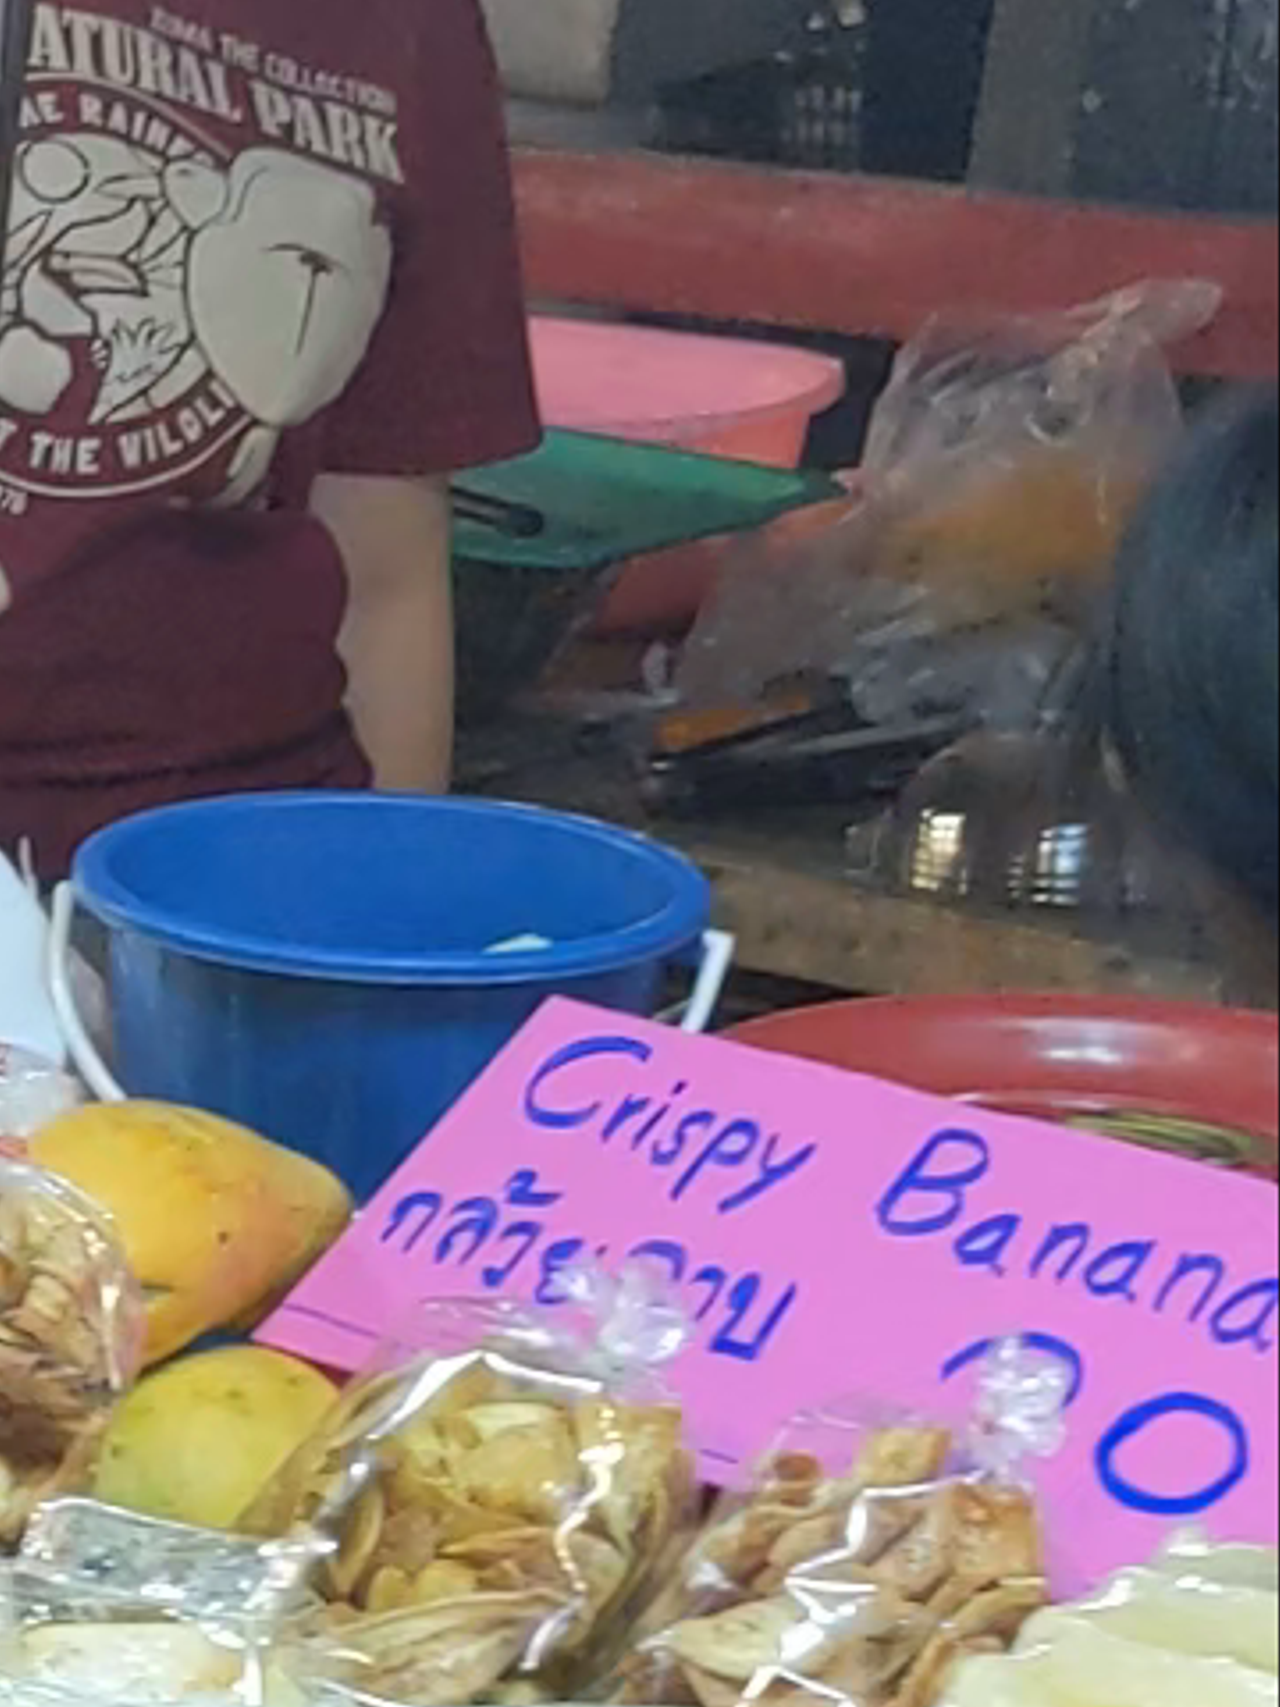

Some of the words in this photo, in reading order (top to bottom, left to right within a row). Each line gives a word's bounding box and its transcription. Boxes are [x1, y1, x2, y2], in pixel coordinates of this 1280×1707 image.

[26, 3, 243, 124] ATURAL
[249, 78, 405, 185] PARK
[28, 430, 101, 474] THE
[520, 1035, 817, 1215] Crispy
[872, 1127, 1280, 1356] Banana
